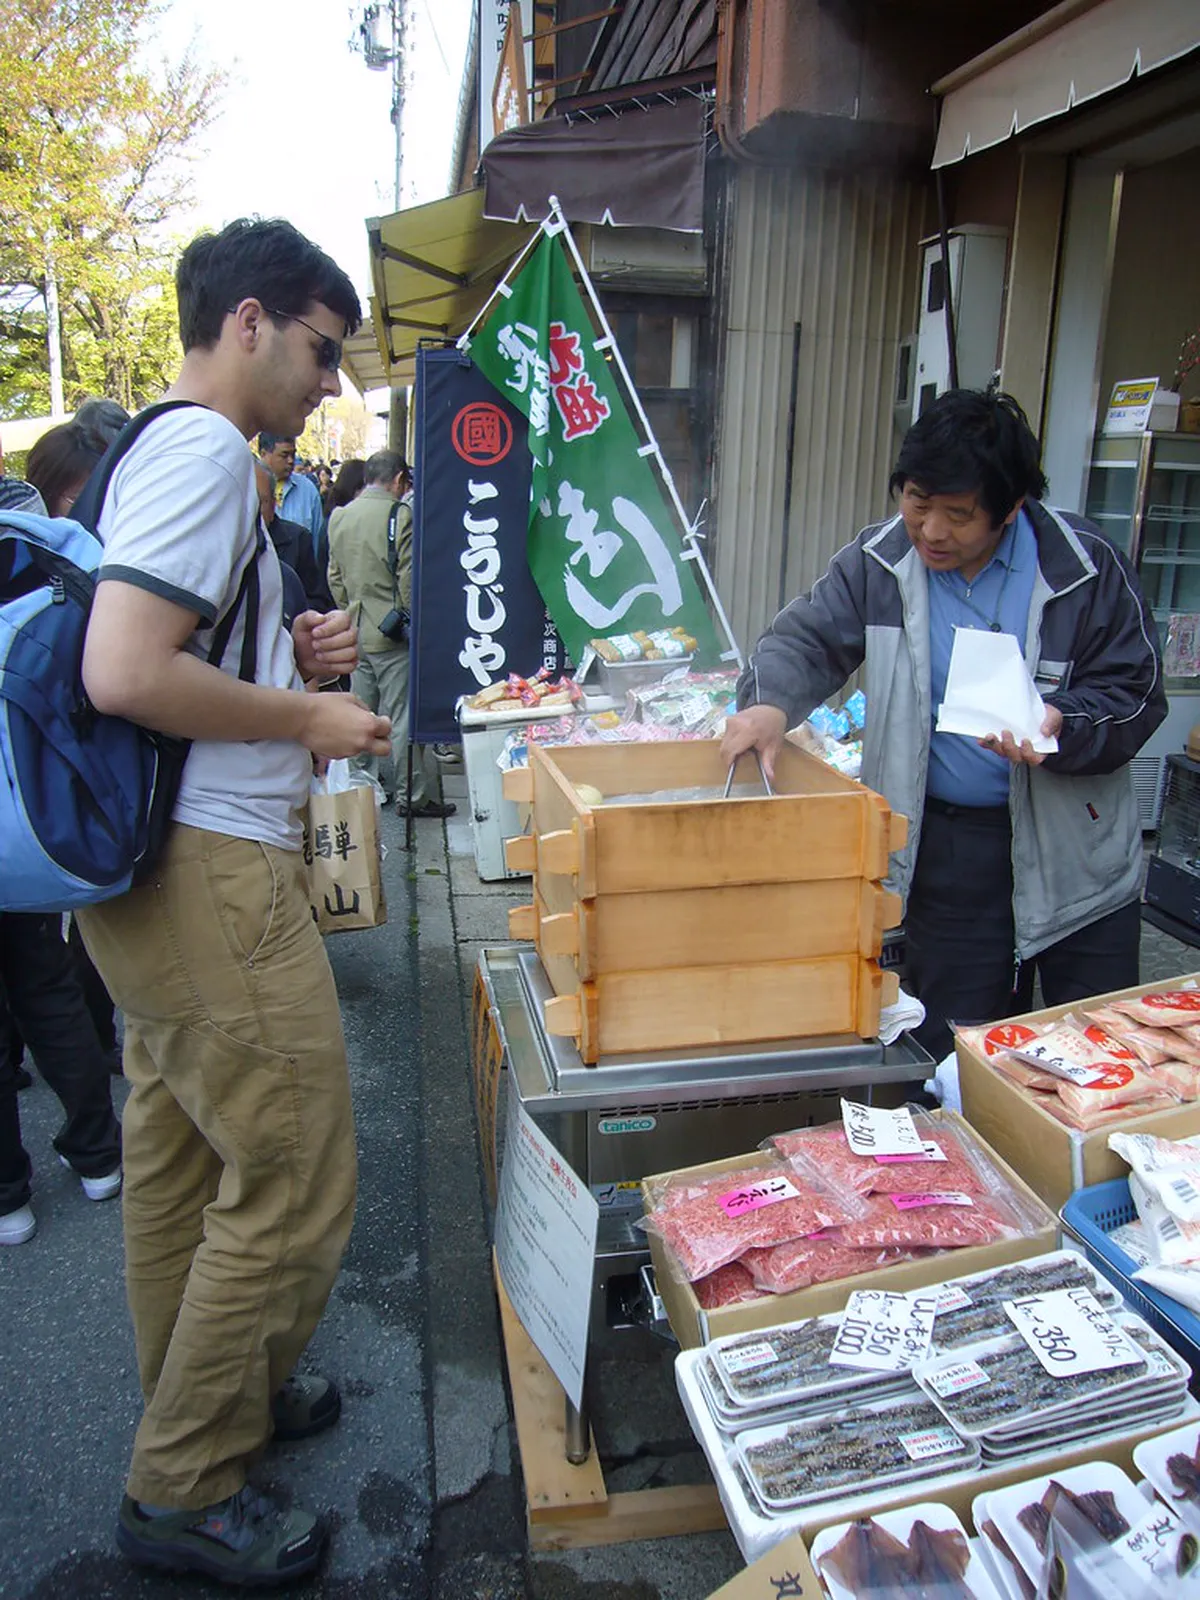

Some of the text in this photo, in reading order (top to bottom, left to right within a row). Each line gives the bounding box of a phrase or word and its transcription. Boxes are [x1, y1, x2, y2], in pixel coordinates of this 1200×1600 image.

[459, 479, 507, 687] こうじや
[310, 883, 360, 923] 山
[602, 1118, 653, 1133] tanico
[849, 1122, 876, 1147] 500
[866, 1322, 901, 1356] 350
[1067, 1290, 1130, 1358] ししゃもみりん
[1032, 1325, 1077, 1362] 350
